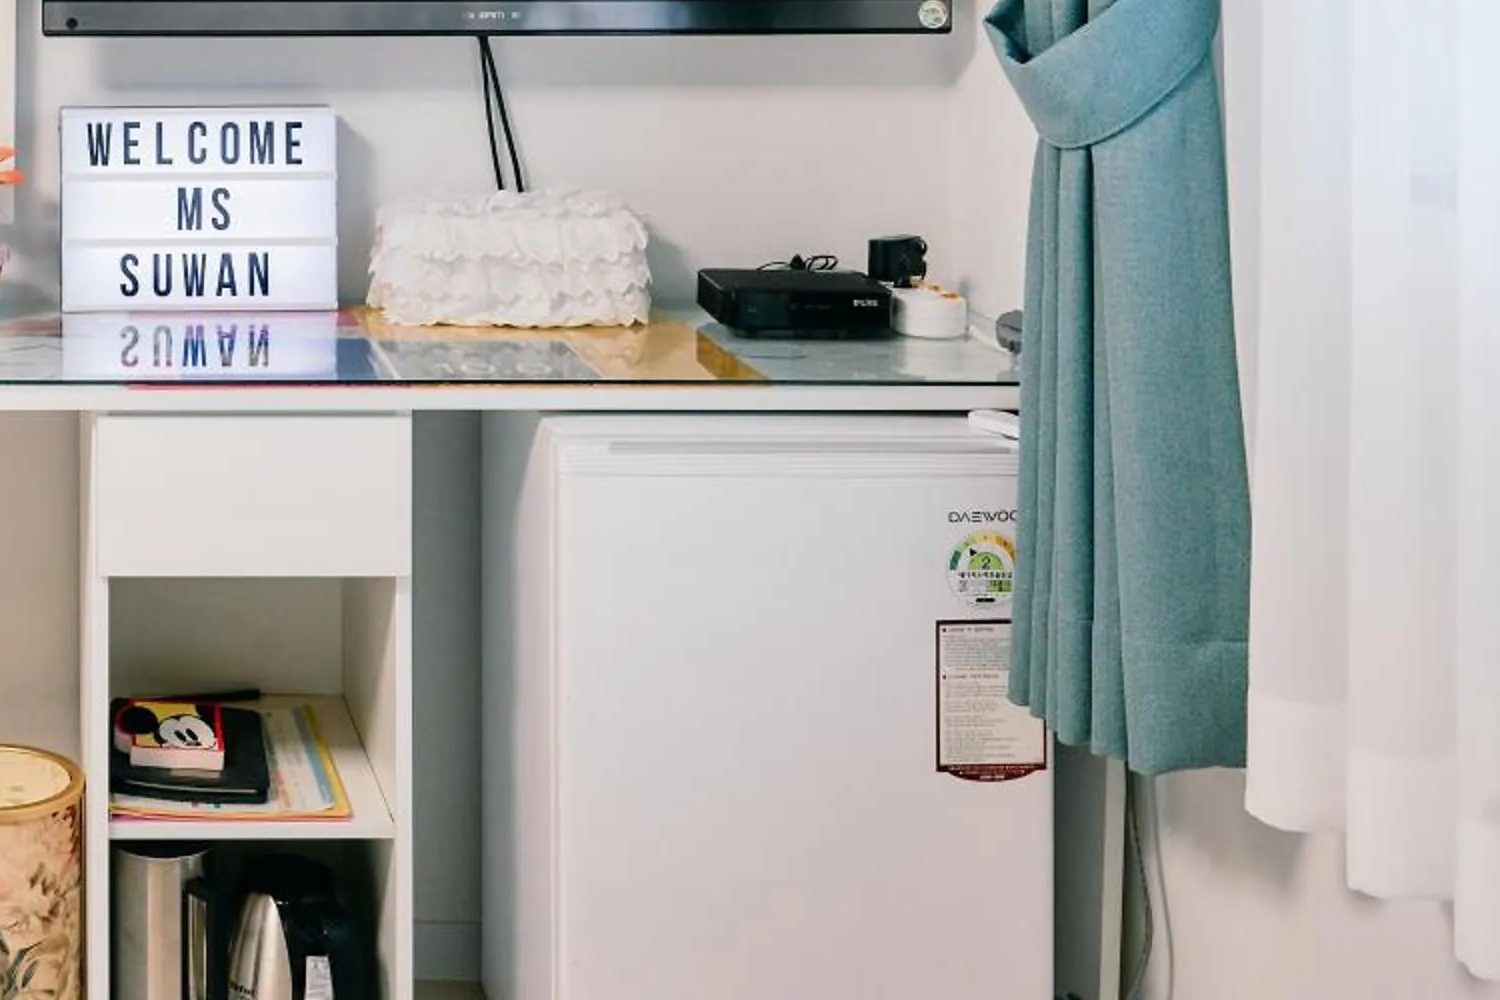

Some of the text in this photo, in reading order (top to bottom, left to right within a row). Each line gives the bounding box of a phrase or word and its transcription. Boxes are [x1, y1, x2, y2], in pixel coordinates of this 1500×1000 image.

[86, 120, 303, 166] WELCOME
[176, 186, 232, 231] MS
[119, 251, 270, 297] SUWAN
[980, 555, 991, 570] 2
